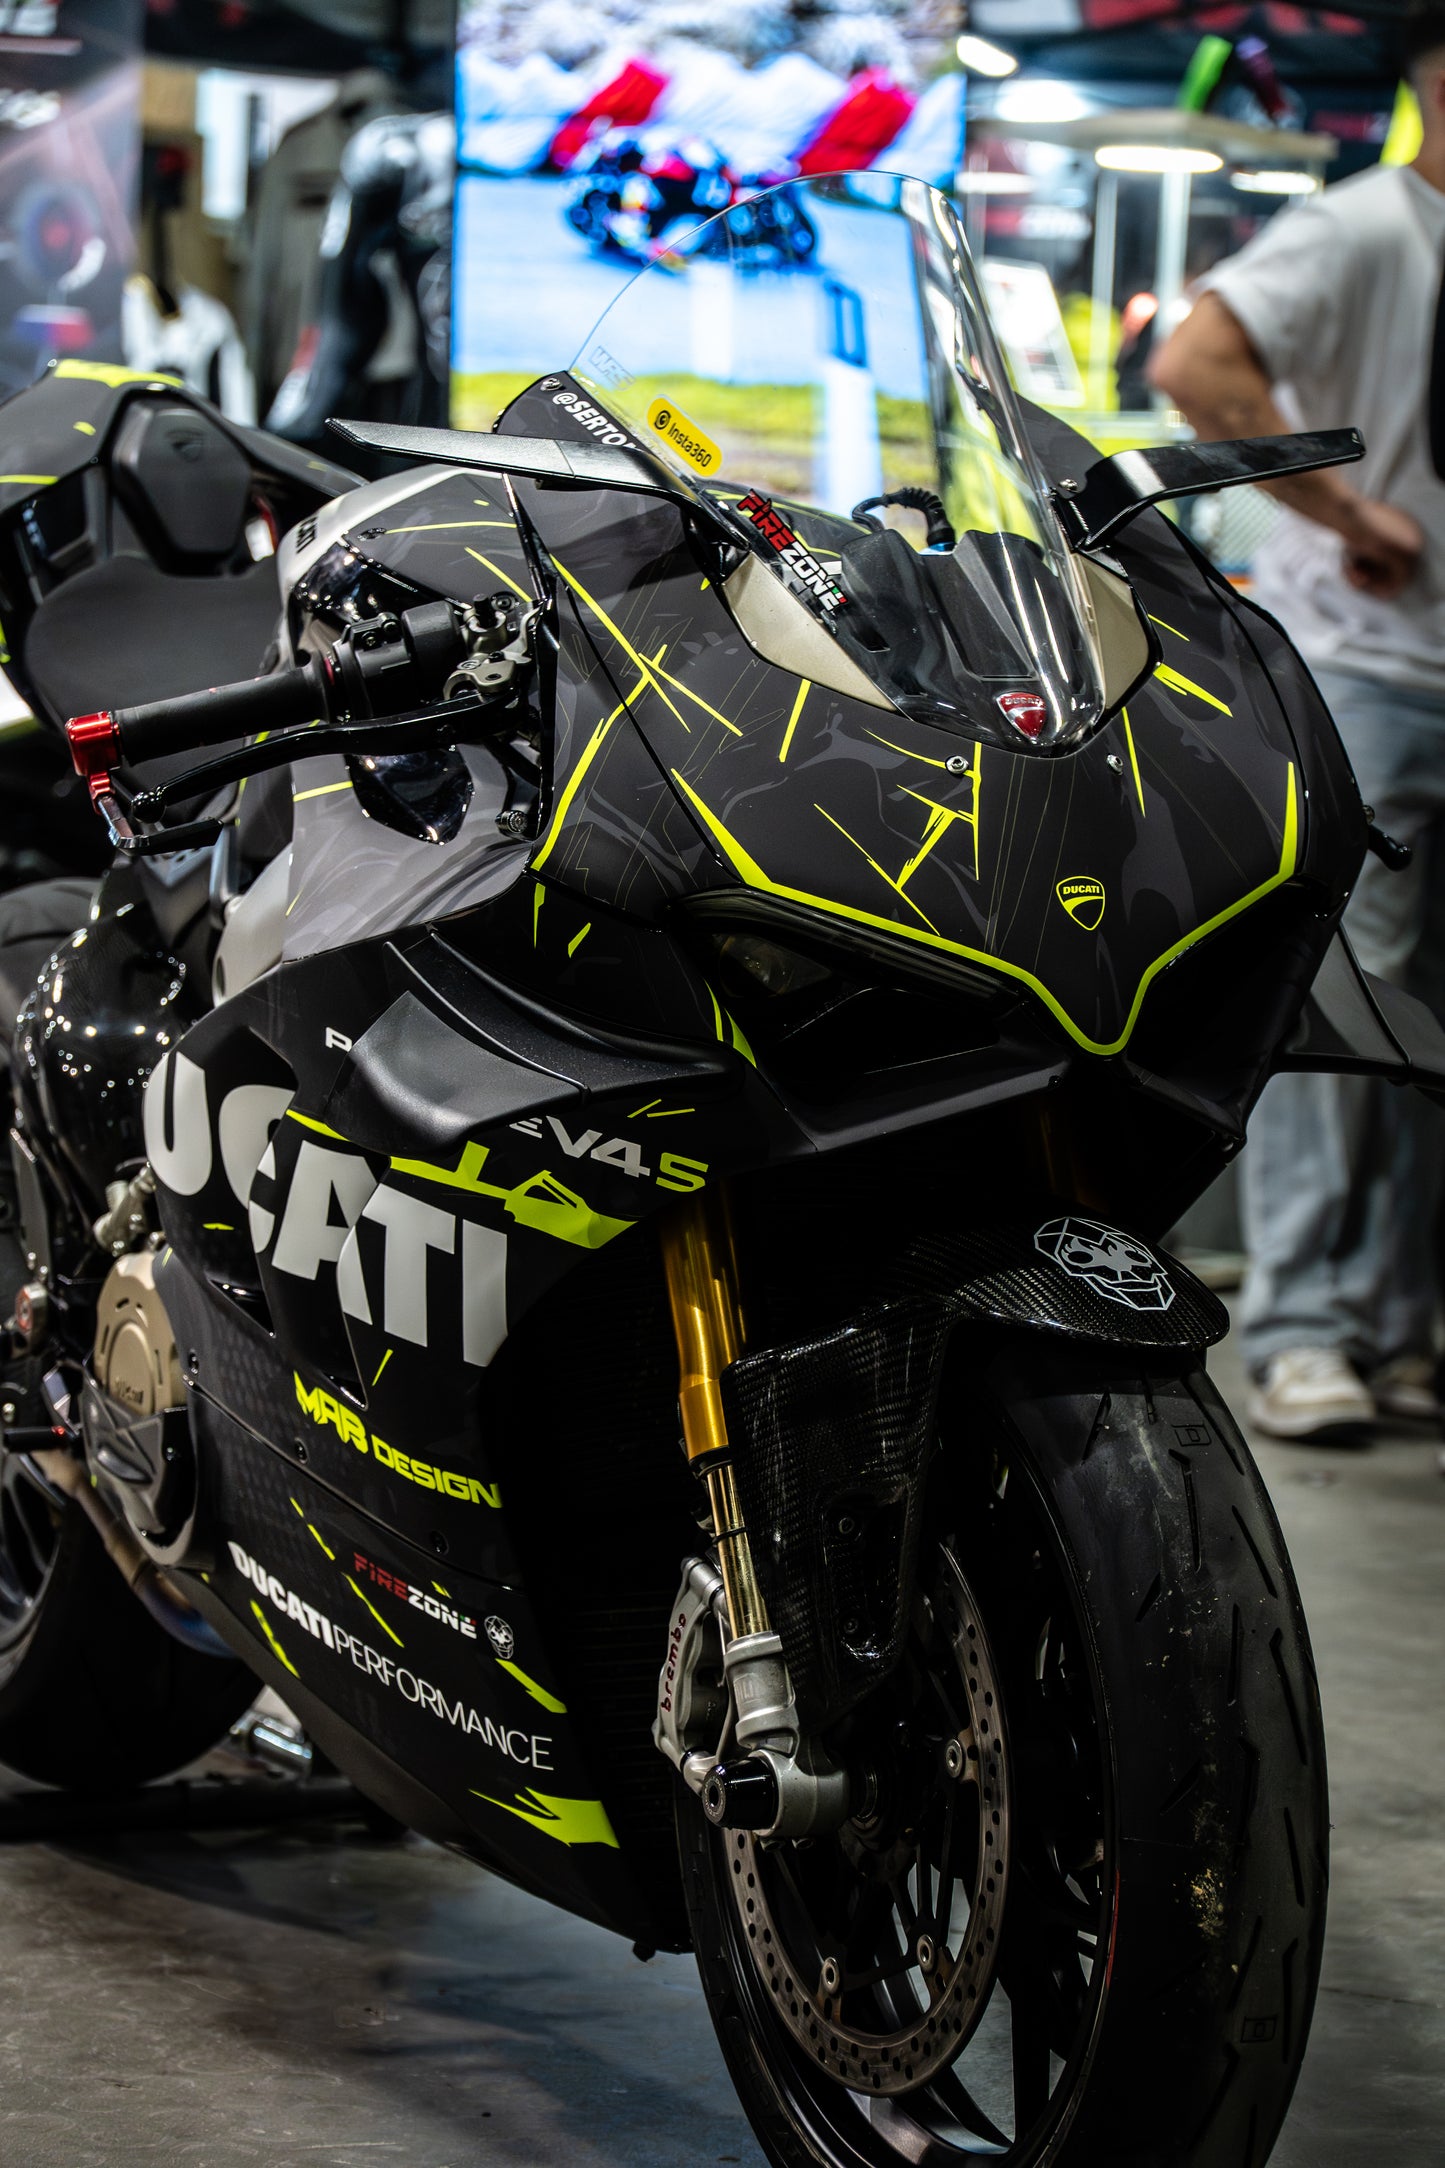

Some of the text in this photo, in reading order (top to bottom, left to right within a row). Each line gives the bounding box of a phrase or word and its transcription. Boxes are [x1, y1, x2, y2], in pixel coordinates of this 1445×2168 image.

[552, 391, 637, 450] @SERTO
[666, 422, 713, 468] Insta360
[1063, 885, 1100, 895] DUCATI
[371, 1433, 503, 1509] DESIGN
[661, 1612, 687, 1713] brembo
